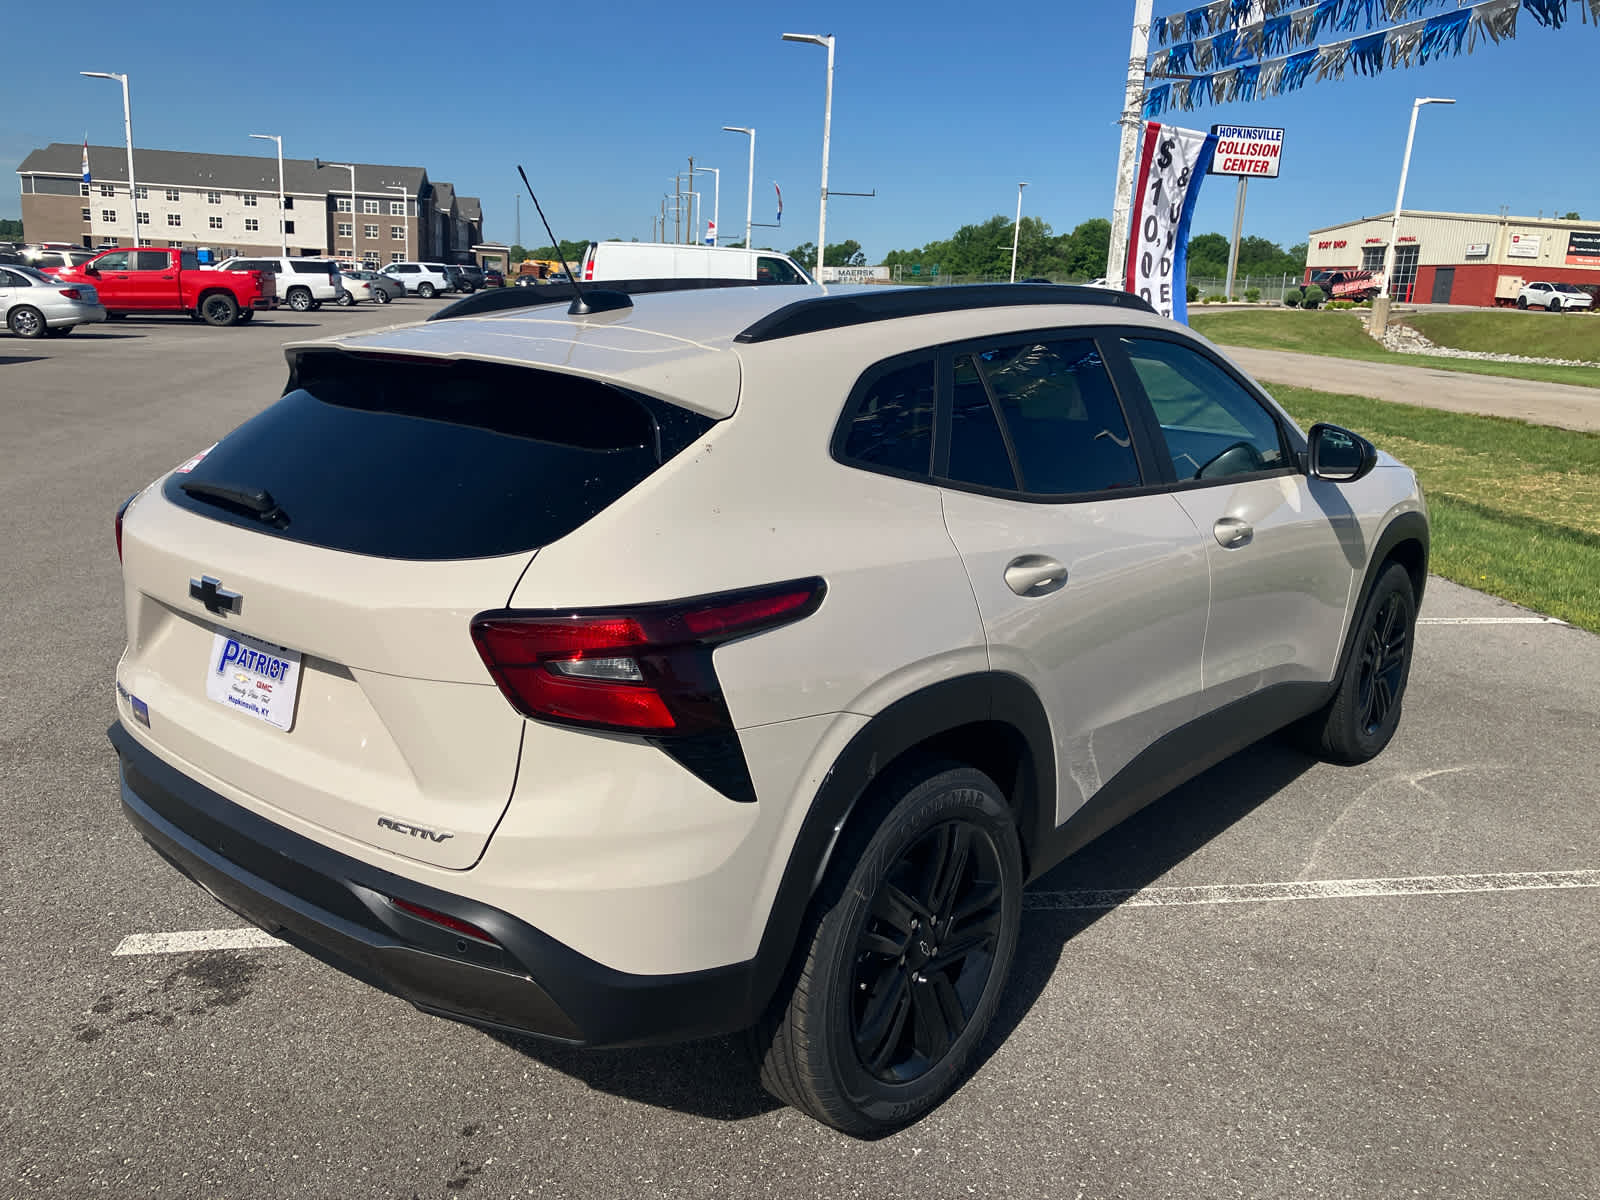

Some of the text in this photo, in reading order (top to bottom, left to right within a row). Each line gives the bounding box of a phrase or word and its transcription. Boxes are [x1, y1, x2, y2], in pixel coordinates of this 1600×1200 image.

[1219, 126, 1282, 141] HOPKINSVILLE
[1217, 141, 1280, 158] COLLISION
[1222, 157, 1270, 174] CENTER
[1333, 240, 1347, 249] SHOP
[218, 639, 289, 681] PATRIOT
